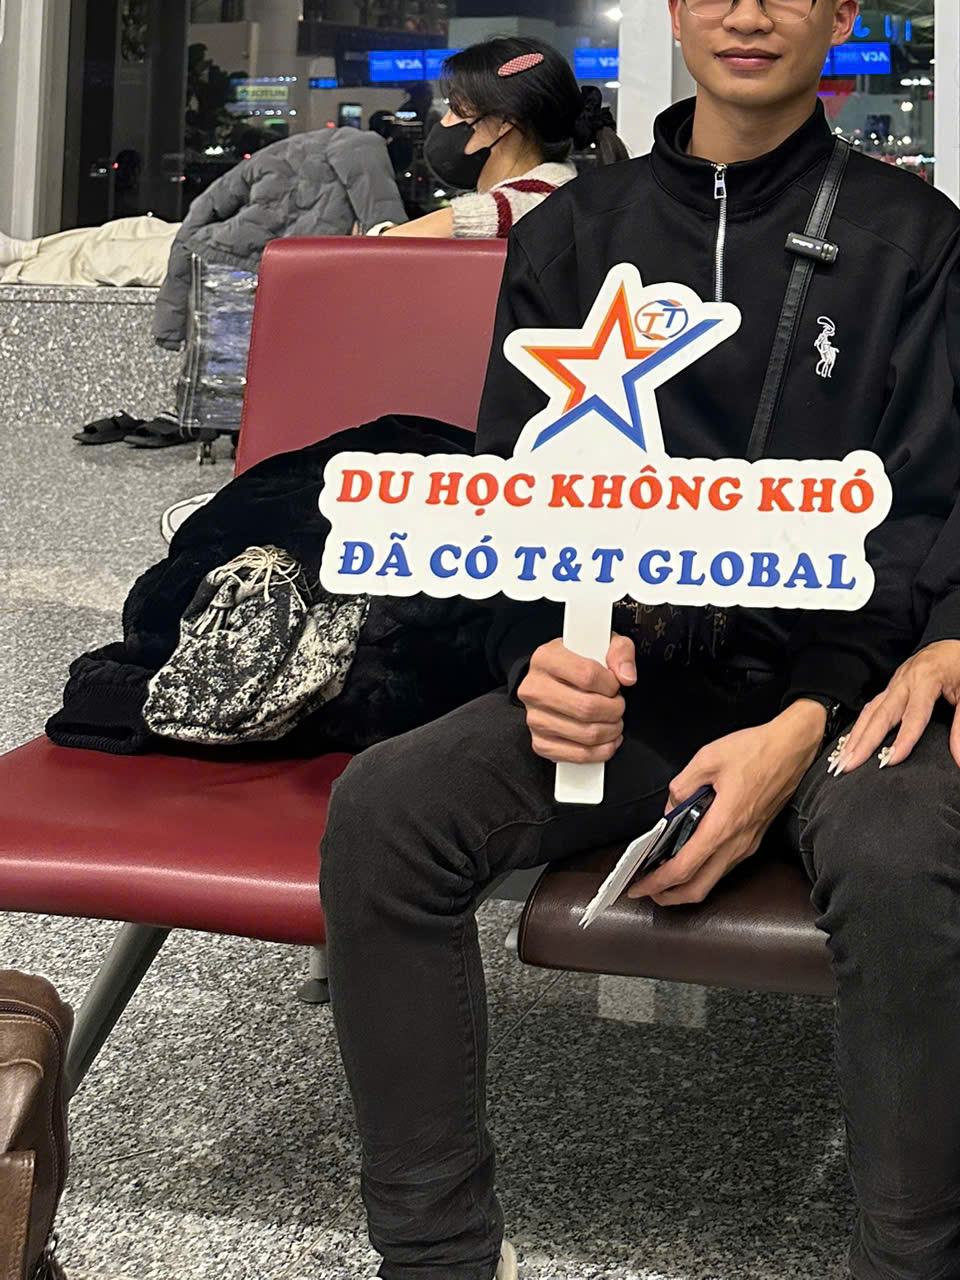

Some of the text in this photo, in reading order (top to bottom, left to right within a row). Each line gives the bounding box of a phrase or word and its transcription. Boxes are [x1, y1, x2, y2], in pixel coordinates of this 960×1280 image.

[335, 464, 875, 517] DU HỌC KHÔNG KHÓ
[338, 532, 857, 590] ĐÃ CÓ T&T GLOBAL
